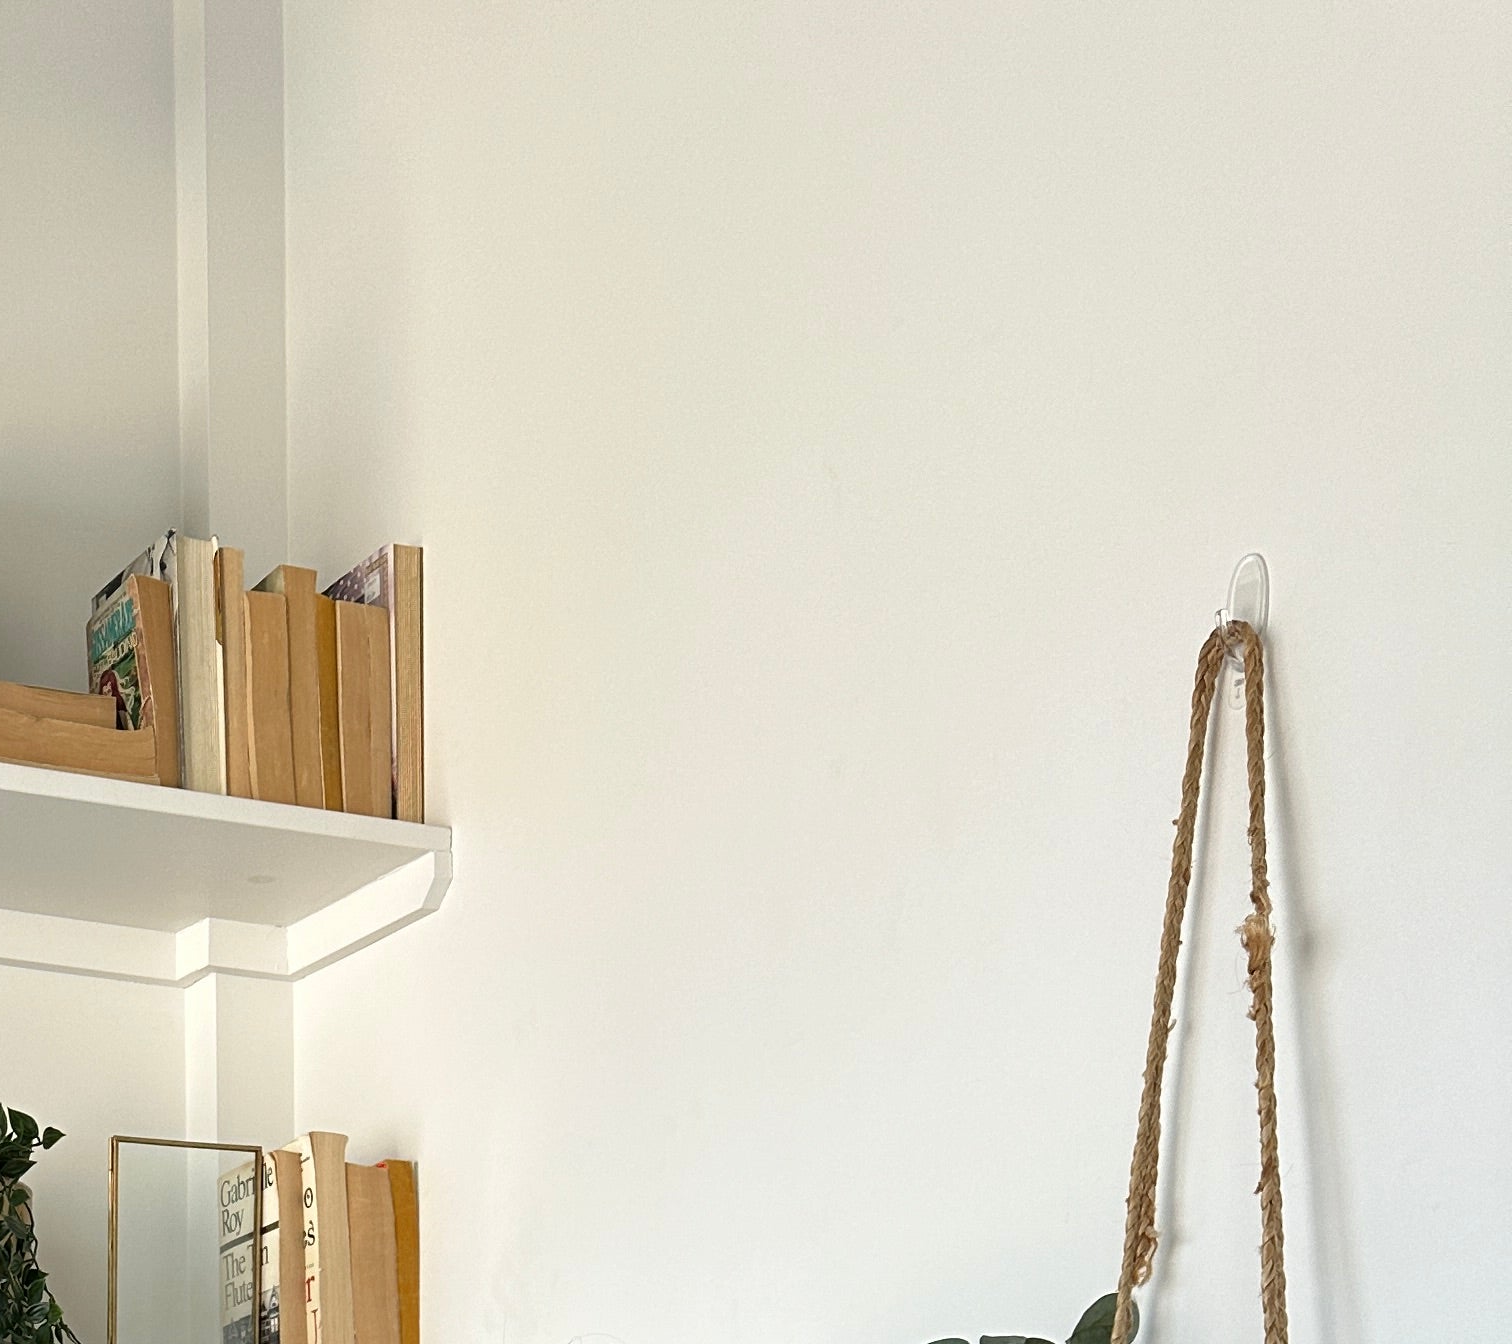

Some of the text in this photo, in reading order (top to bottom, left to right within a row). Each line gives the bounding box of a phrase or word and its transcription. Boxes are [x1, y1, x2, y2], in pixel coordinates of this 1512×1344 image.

[221, 1208, 245, 1237] Roy
[223, 1251, 247, 1281] The
[224, 1281, 253, 1311] Flute
